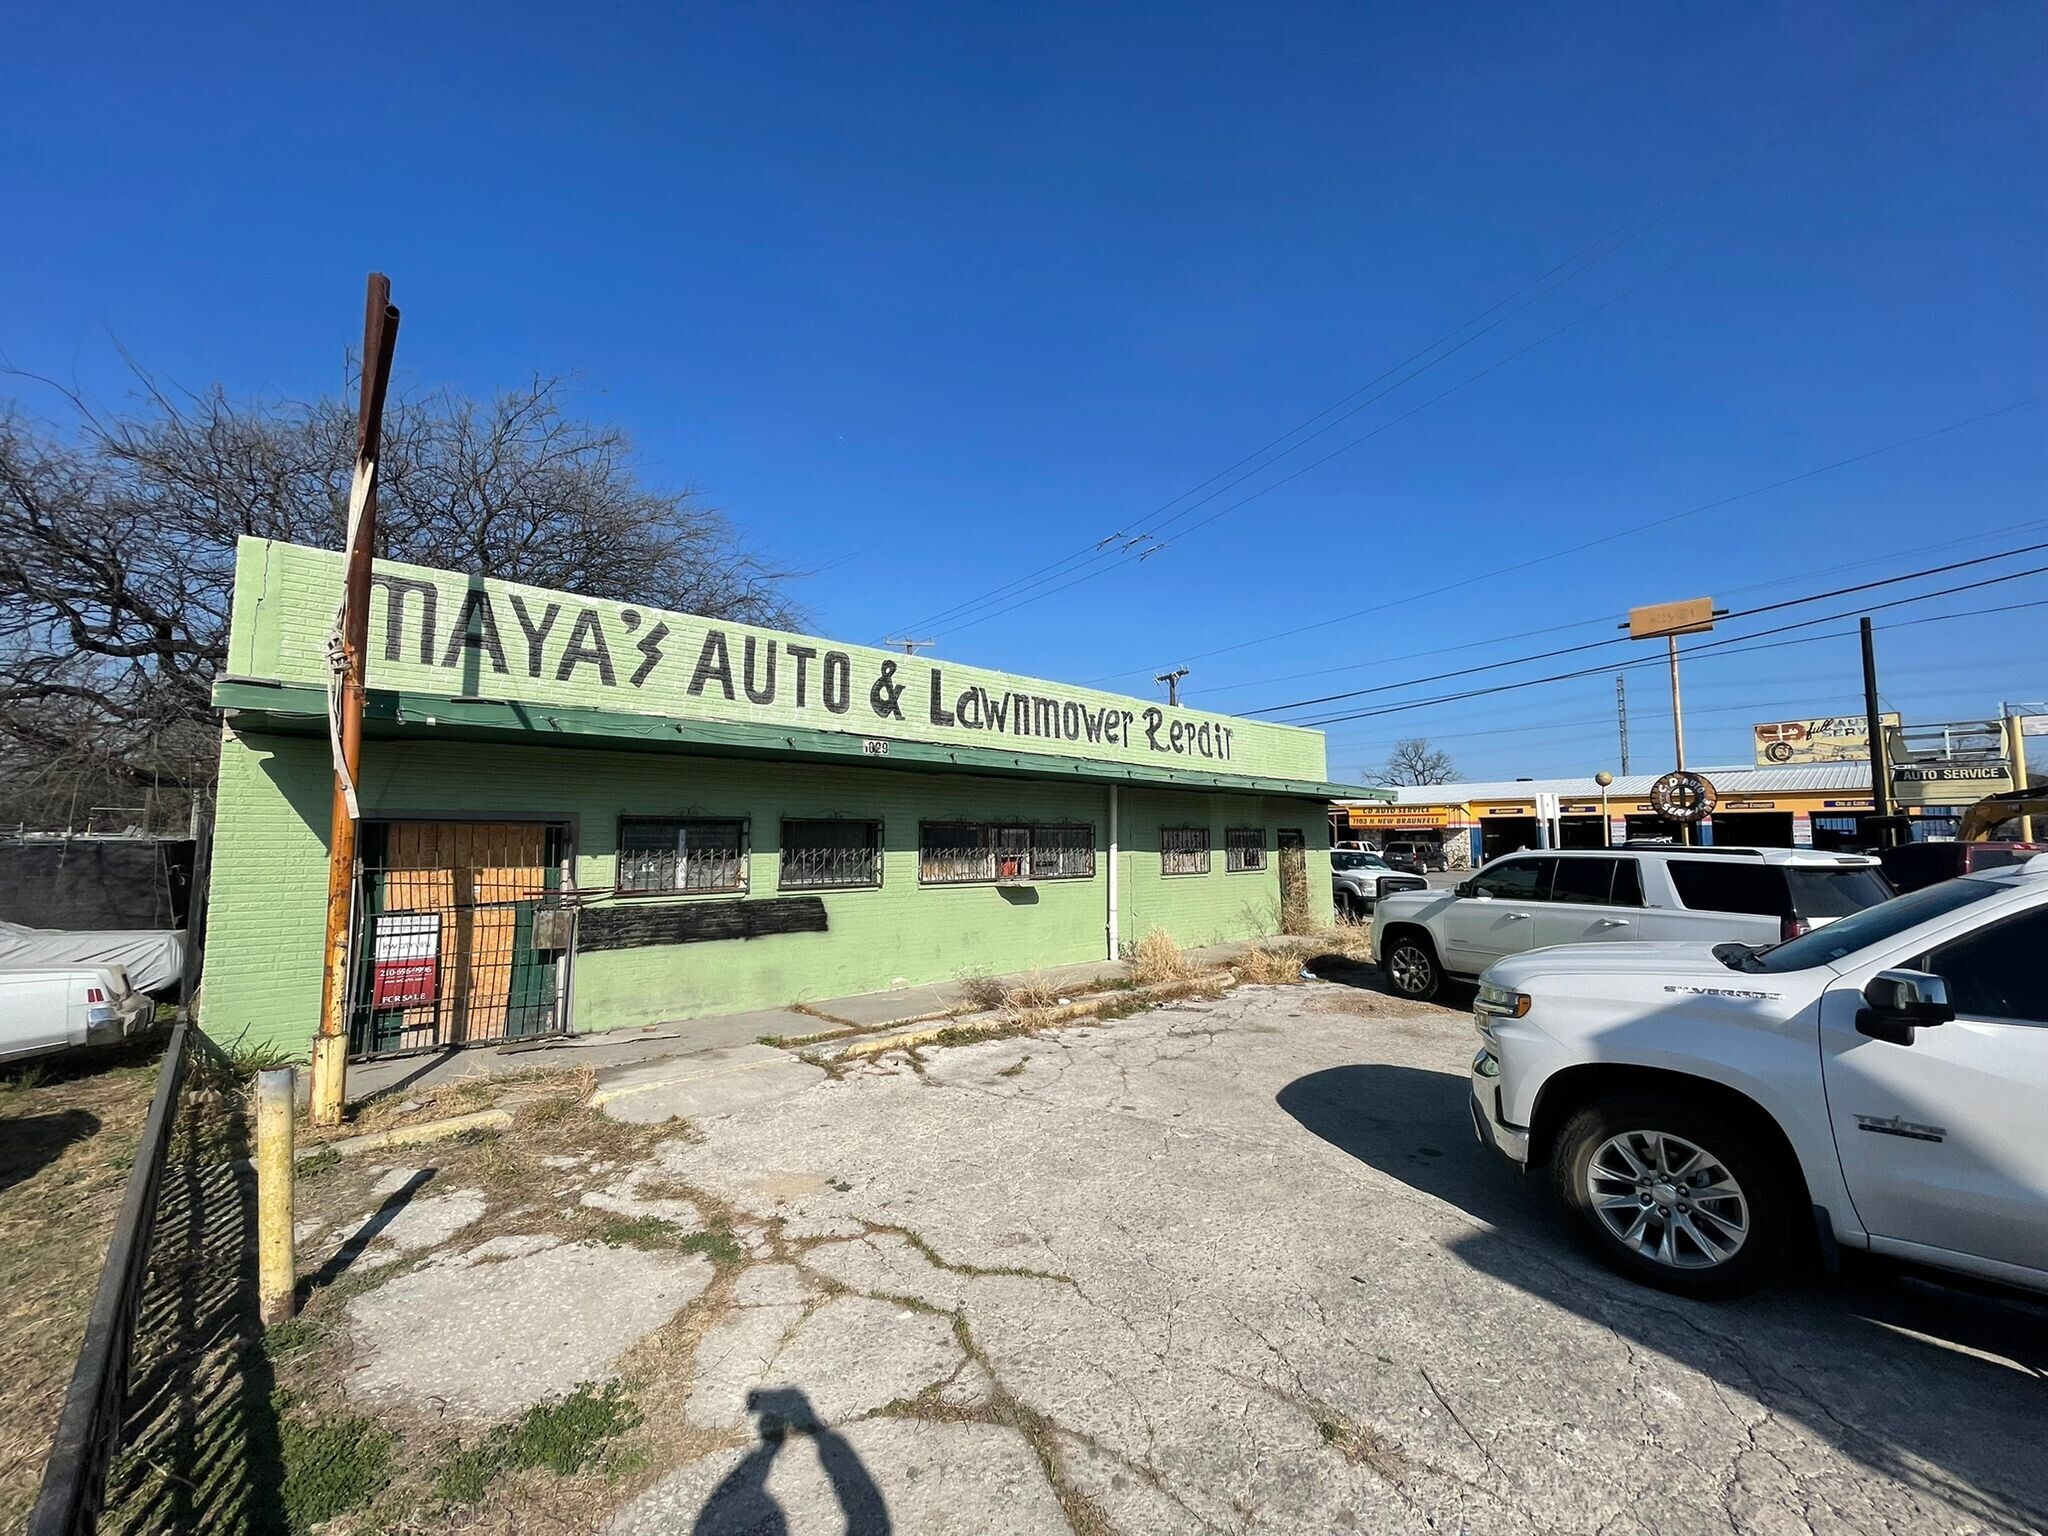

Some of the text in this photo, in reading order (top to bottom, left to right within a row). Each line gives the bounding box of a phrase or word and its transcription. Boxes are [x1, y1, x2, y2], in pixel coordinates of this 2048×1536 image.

[687, 629, 850, 715] AUTO
[870, 659, 906, 721] &
[930, 668, 1133, 748] Lawnmower
[1143, 706, 1234, 761] Repair
[1903, 767, 2000, 781] AUTO SERVICE
[1682, 777, 1705, 794] AUTO
[1398, 806, 1430, 814] SERVICE
[1396, 816, 1440, 825] BRAUNFELS
[382, 993, 426, 1003] FOR SALE
